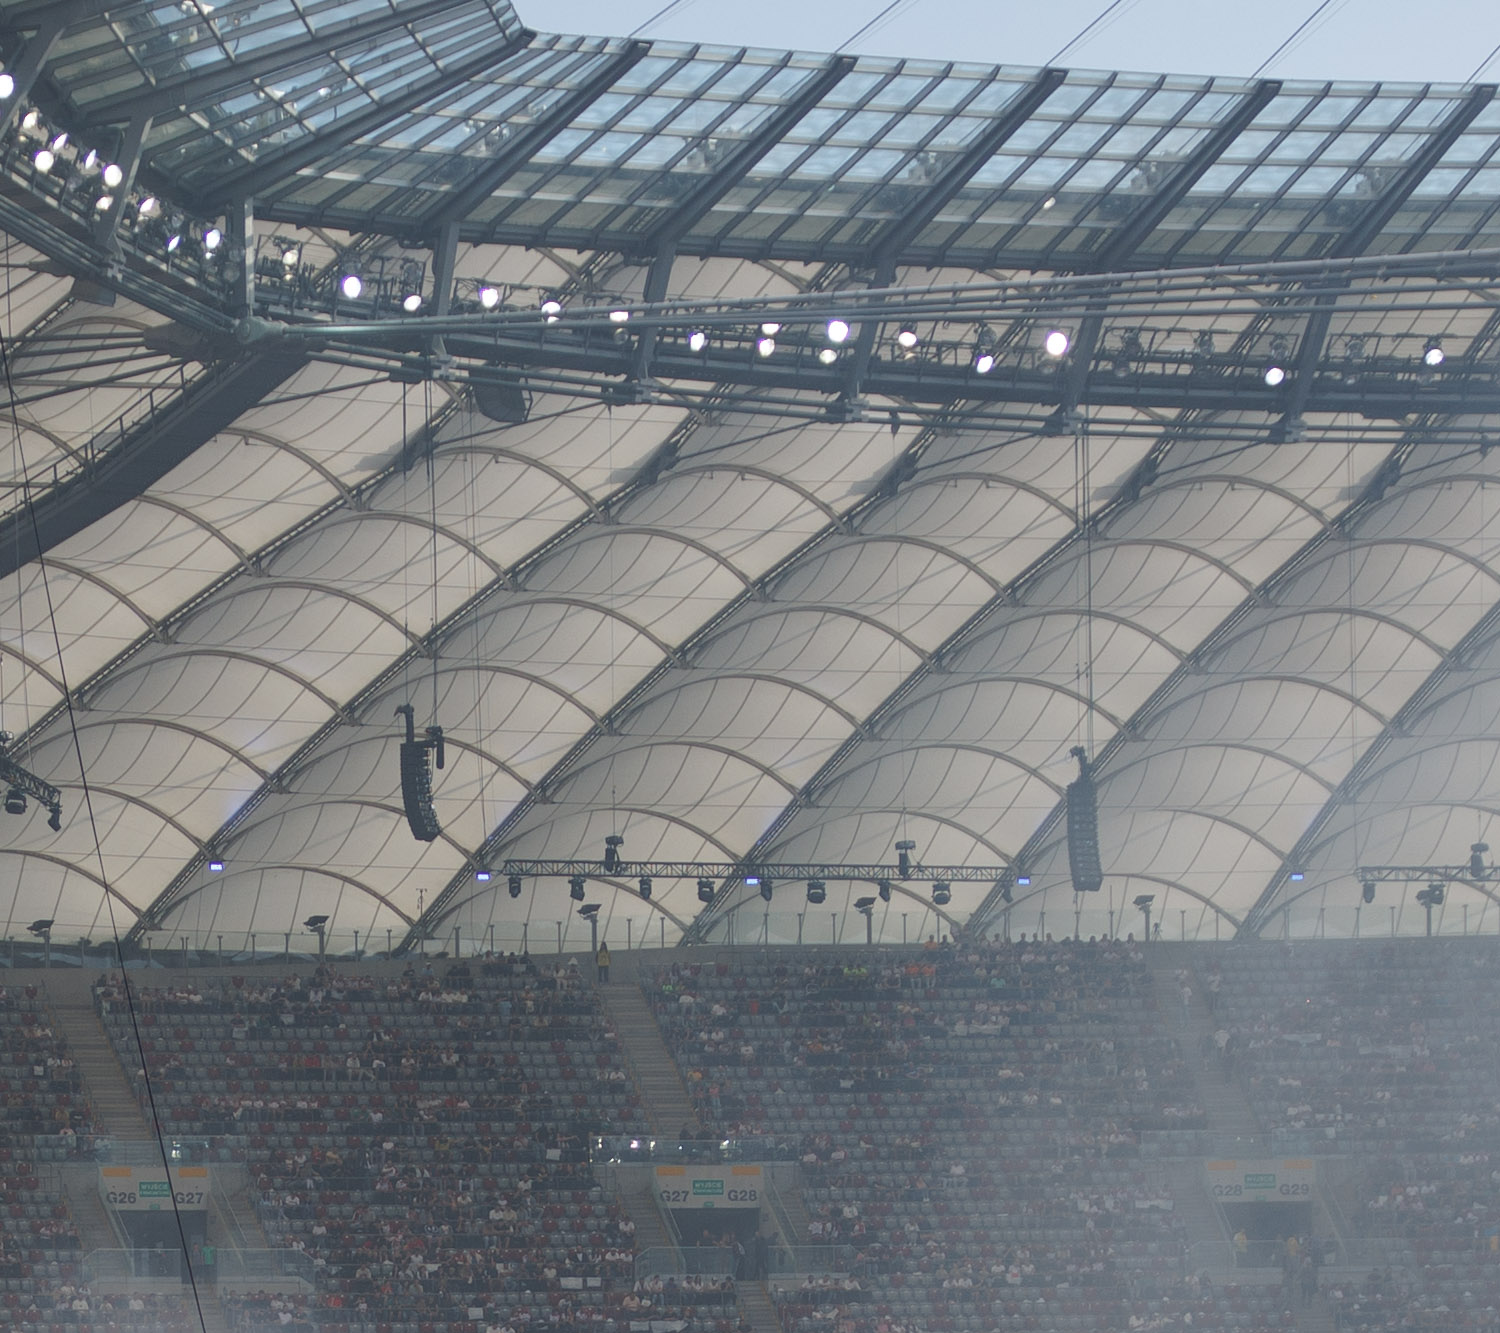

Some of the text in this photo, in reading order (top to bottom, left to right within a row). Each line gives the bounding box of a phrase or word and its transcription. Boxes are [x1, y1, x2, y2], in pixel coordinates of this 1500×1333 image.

[106, 1192, 204, 1204] G26 G27
[728, 1190, 757, 1201] G28
